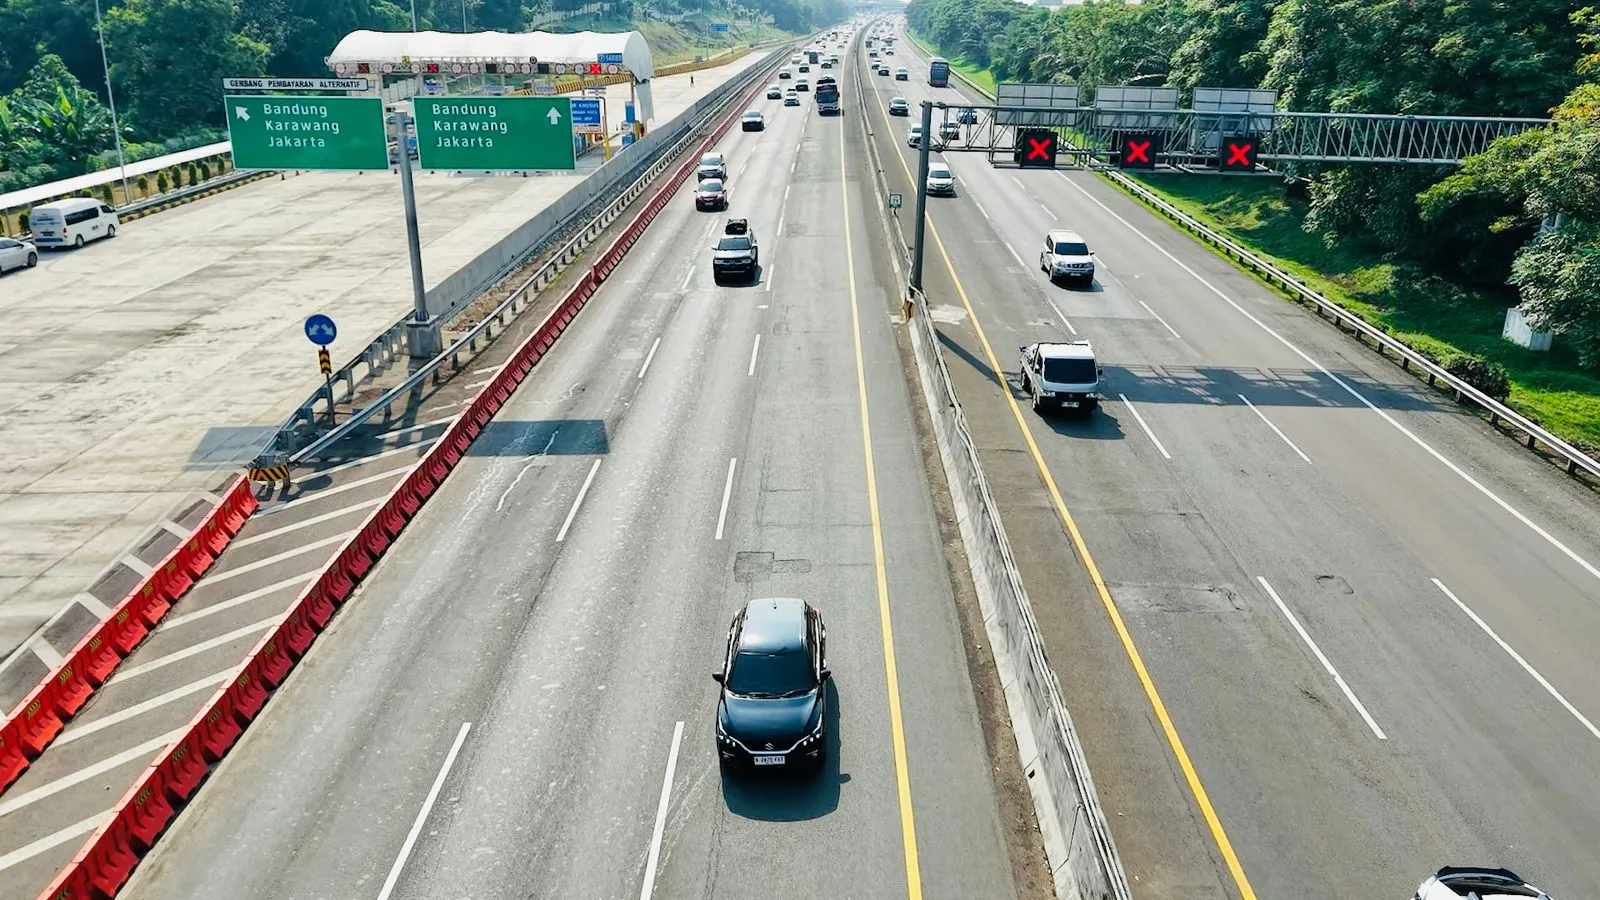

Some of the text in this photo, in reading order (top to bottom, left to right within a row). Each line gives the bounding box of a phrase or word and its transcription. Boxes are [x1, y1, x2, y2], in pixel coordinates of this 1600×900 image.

[268, 80, 314, 88] PEMBAYARAN
[263, 103, 328, 117] Bandung
[432, 103, 497, 117] Bandung
[265, 120, 340, 134] Karawang
[434, 120, 508, 134] Karawang
[269, 136, 325, 147] Jakarta
[437, 136, 493, 148] Jakarta
